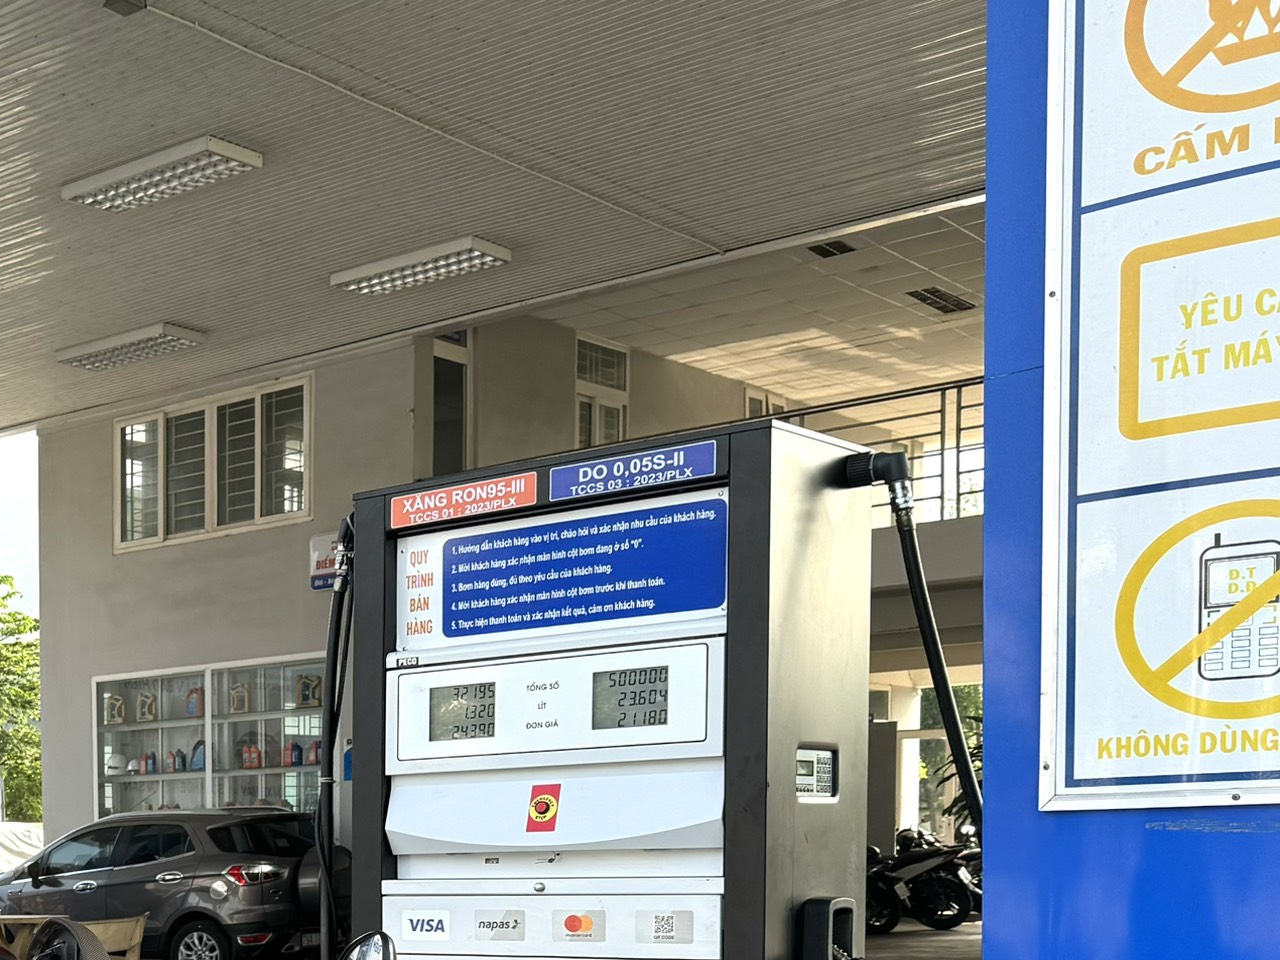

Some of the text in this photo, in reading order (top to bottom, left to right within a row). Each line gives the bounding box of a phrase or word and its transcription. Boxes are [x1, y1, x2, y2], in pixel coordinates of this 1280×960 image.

[1133, 122, 1251, 176] CẤM
[1179, 291, 1244, 330] YÊU
[1151, 339, 1211, 382] TẮT
[579, 451, 685, 483] DO 0,05S-II
[570, 467, 693, 496] TCCS 03 2023/PLX
[403, 478, 525, 513] XĂNG RON95-III
[409, 496, 517, 524] TCCS 01 2023/PLX
[493, 539, 512, 550] khách
[631, 519, 644, 529] nhu
[673, 512, 695, 523] khách
[410, 549, 429, 568] QUY
[406, 570, 434, 590] TRÌNH
[409, 594, 430, 613] BÁN
[406, 617, 433, 636] HÀNG
[398, 657, 417, 666] PECO
[526, 680, 560, 692] TỔNG SỐ
[609, 668, 667, 687] 500000
[453, 685, 495, 700] 32195
[618, 689, 667, 707] 23.604
[618, 709, 667, 727] 21180
[452, 722, 495, 739] 24390
[1097, 724, 1279, 760] KHÔNG DÙNG
[407, 919, 445, 932] VISA
[478, 920, 510, 931] napas
